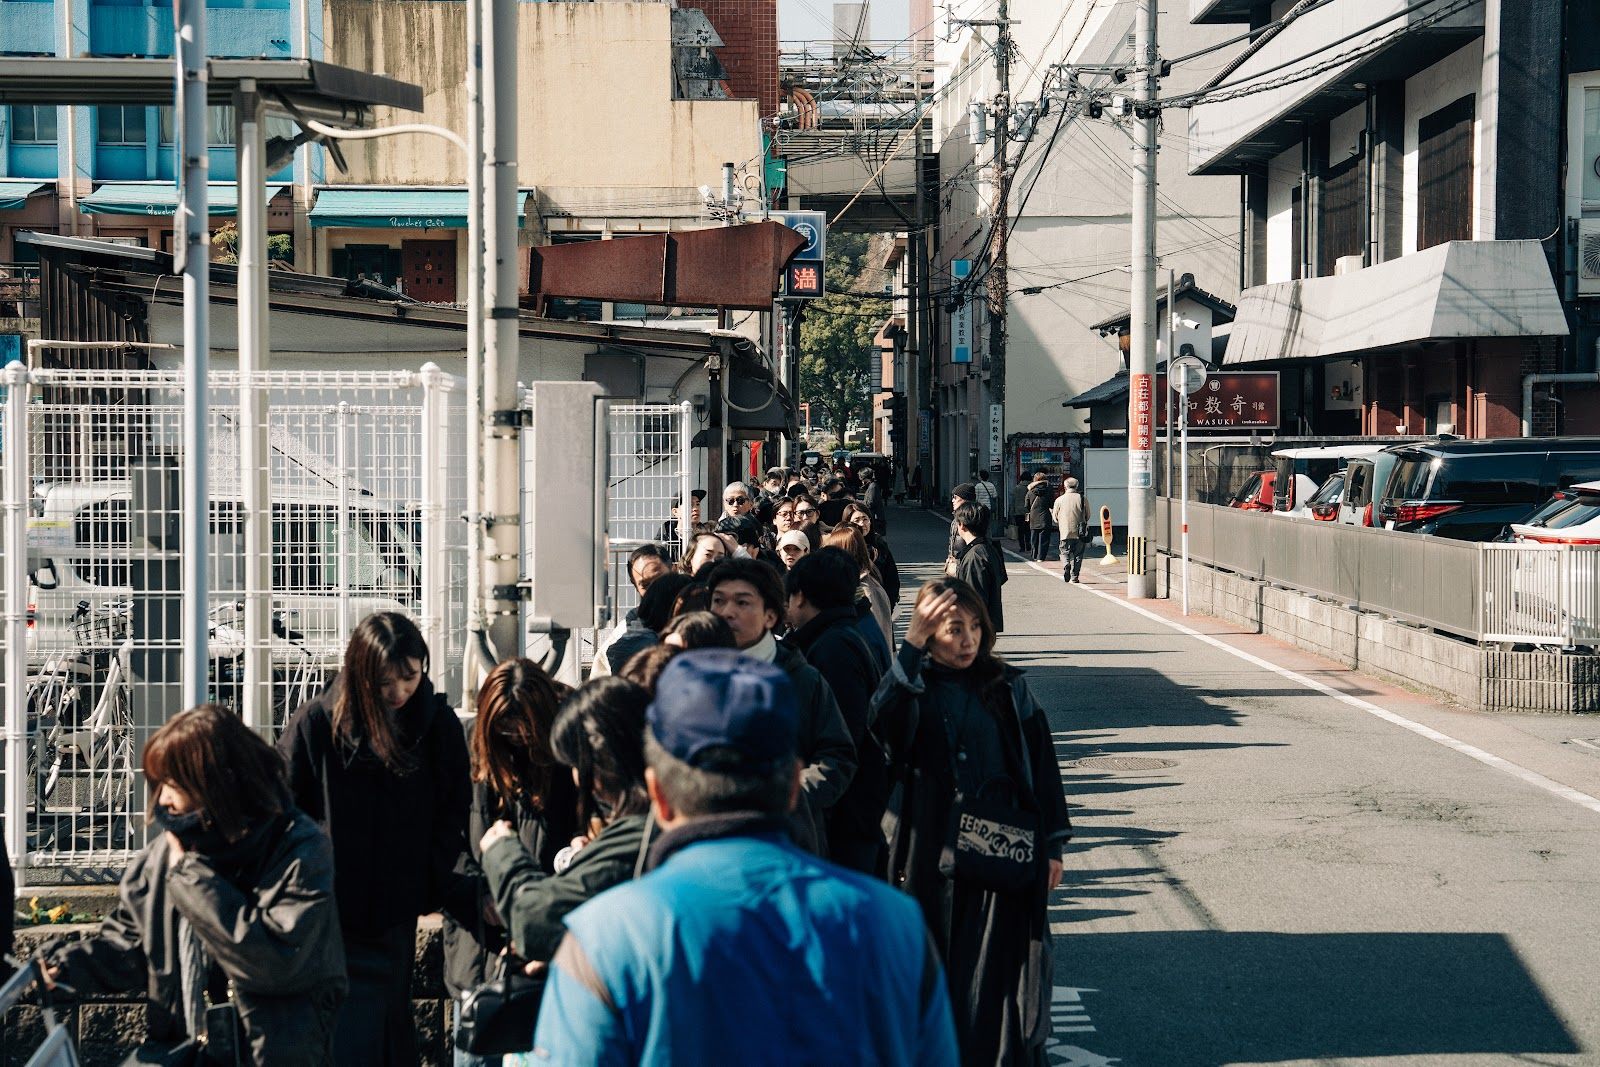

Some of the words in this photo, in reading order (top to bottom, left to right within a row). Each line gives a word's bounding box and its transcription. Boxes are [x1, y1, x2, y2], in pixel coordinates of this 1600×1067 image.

[794, 267, 817, 290] 満
[1138, 376, 1149, 448] 古荘都市開発
